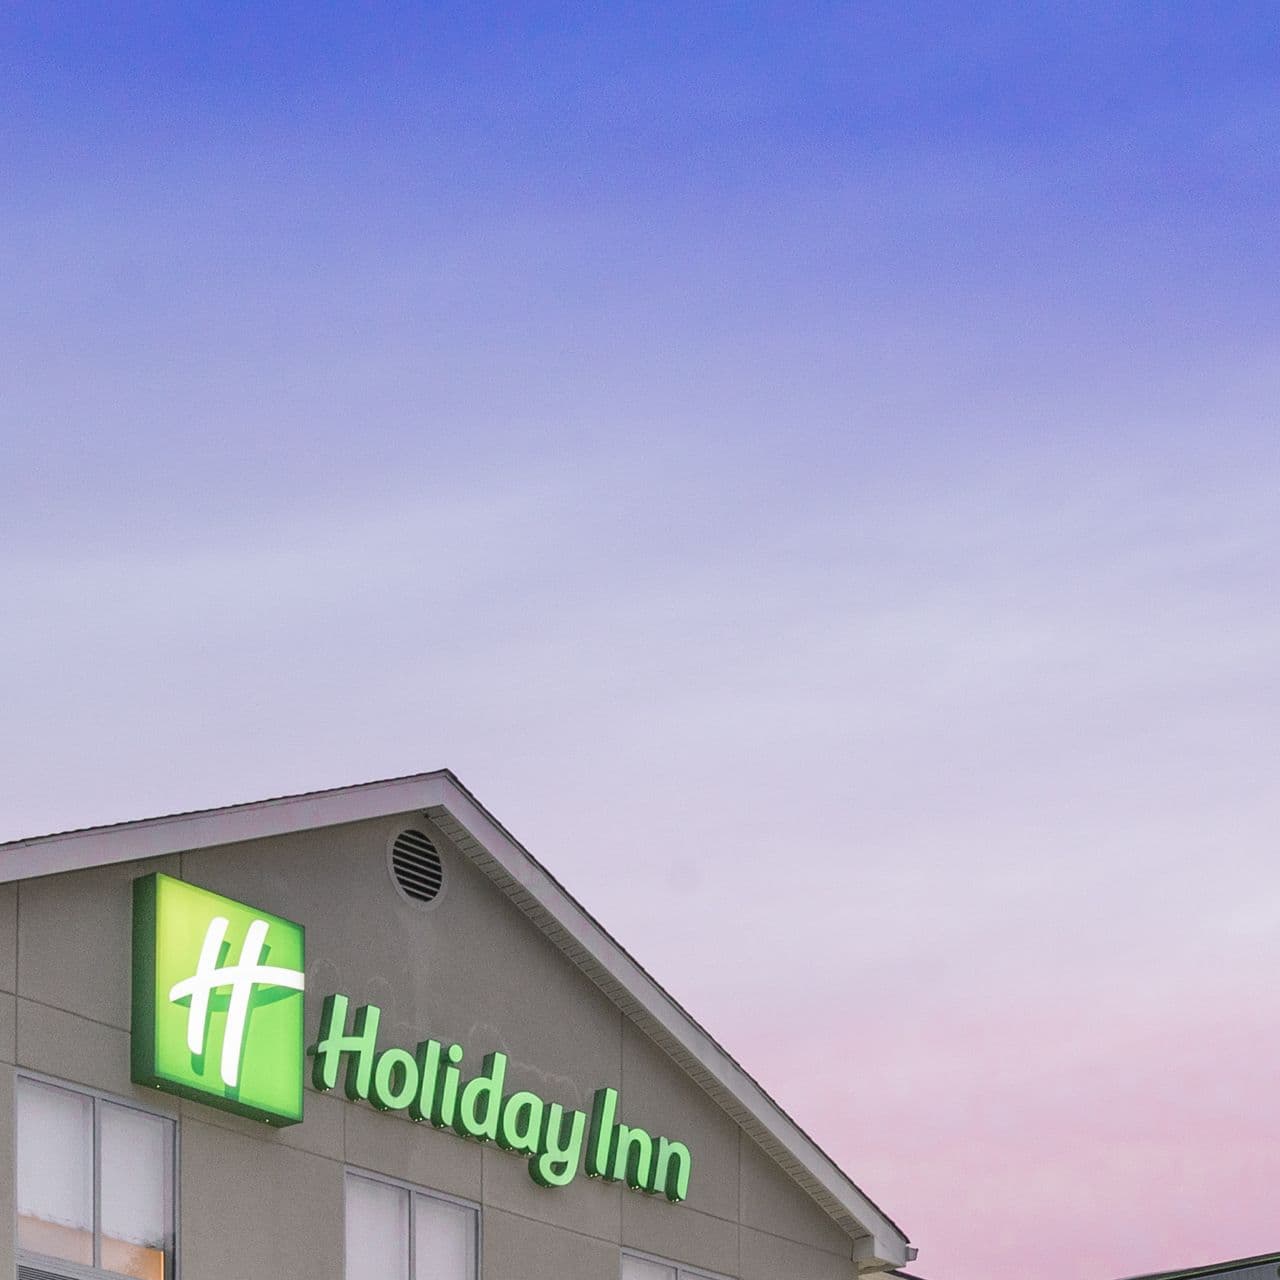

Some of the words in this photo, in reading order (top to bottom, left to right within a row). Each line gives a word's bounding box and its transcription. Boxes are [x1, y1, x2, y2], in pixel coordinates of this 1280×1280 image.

[169, 916, 305, 1087] H
[310, 993, 586, 1187] Holiday
[586, 1087, 692, 1201] Inn
